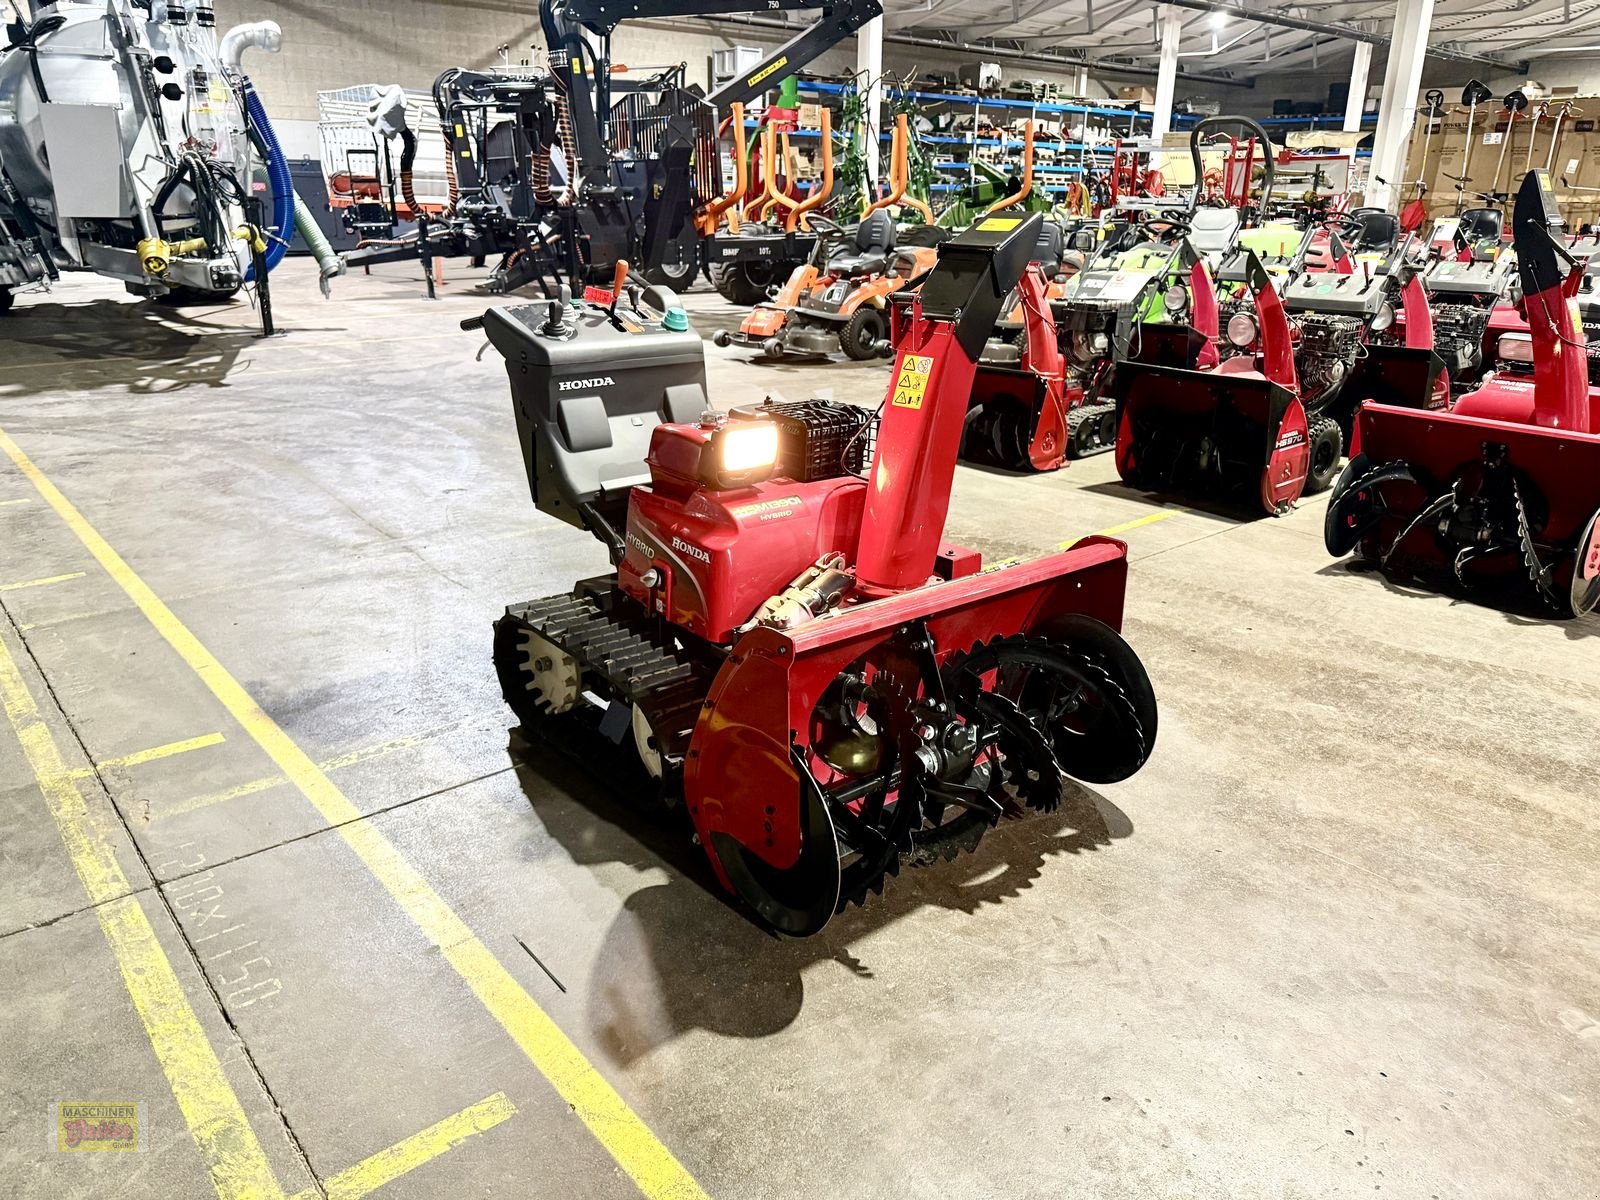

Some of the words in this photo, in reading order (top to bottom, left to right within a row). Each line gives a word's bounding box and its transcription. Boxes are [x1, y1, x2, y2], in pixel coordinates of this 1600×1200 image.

[767, 0, 780, 9] 750
[558, 376, 616, 391] HONDA
[1275, 434, 1303, 449] HS970
[1281, 429, 1299, 439] HONDA
[760, 510, 792, 521] HYBRID
[625, 532, 655, 559] HYBRID
[671, 536, 711, 564] HONDA
